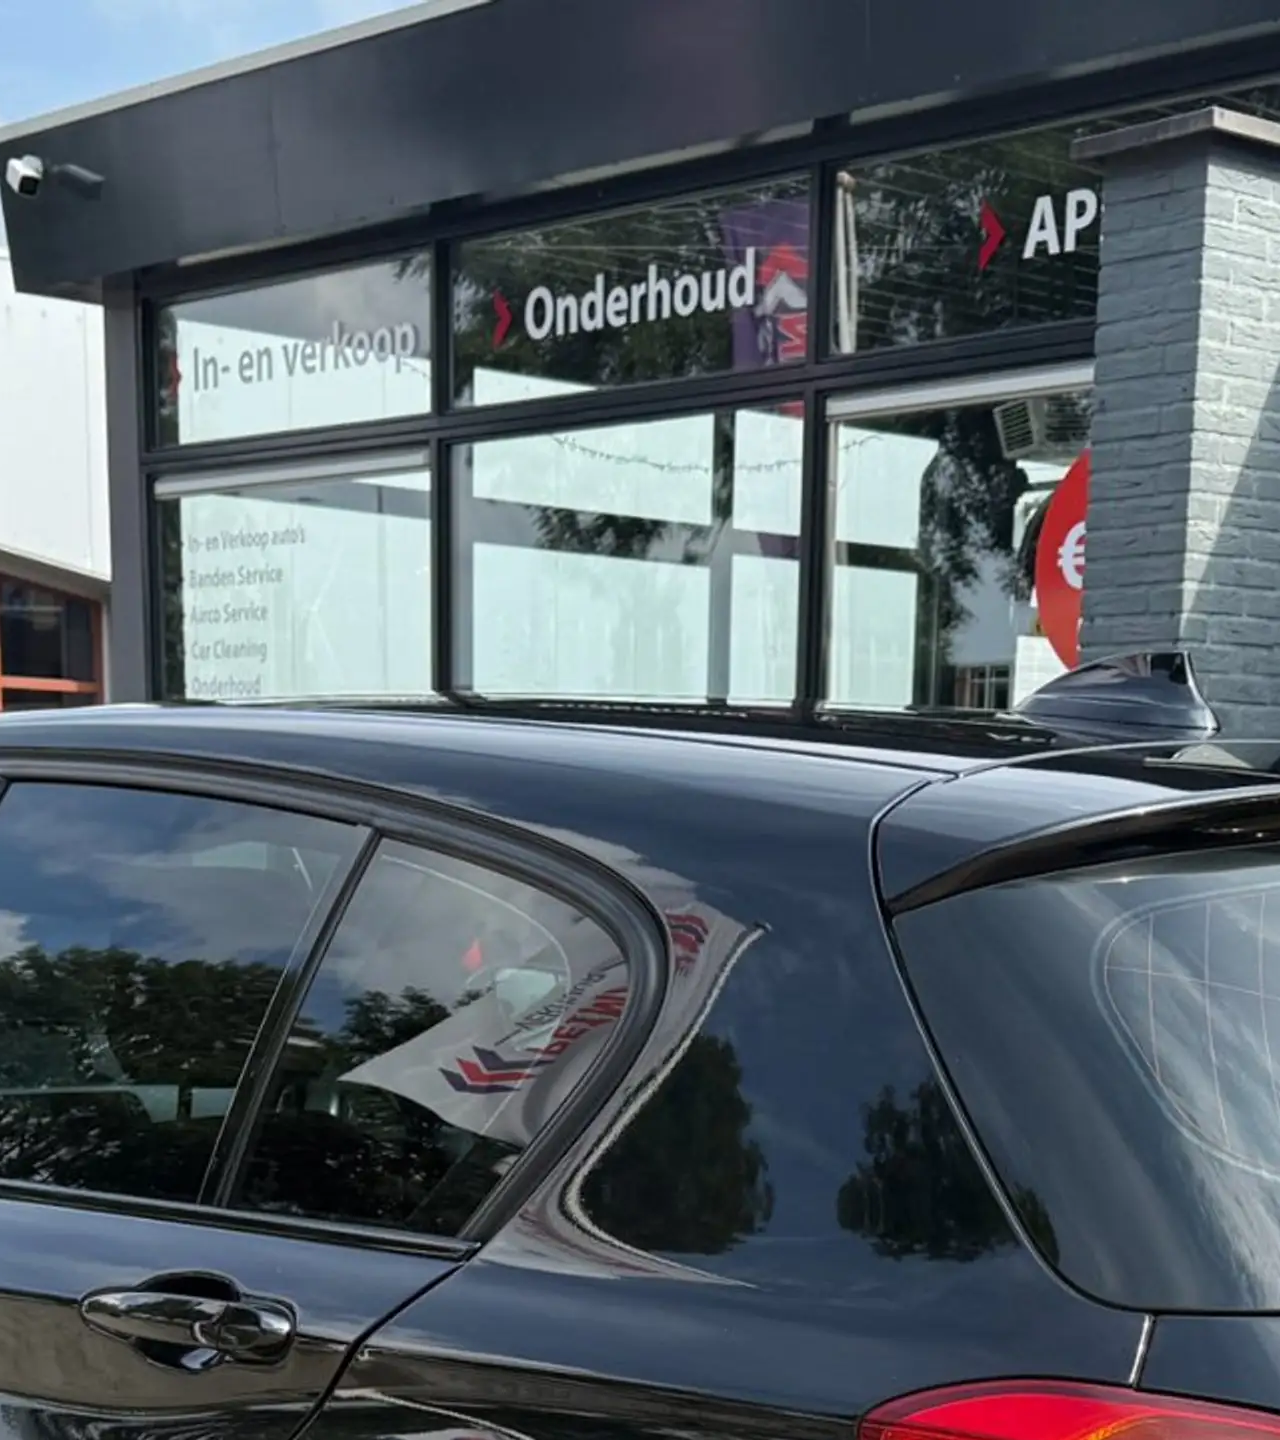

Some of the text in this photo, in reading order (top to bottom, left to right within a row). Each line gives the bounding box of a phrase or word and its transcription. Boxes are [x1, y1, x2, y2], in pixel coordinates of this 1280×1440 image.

[1022, 188, 1105, 259] AP
[524, 246, 756, 340] Onderhoud
[193, 321, 417, 391] In- en verkoop
[220, 529, 269, 550] Verkoop
[189, 563, 283, 588] Banden Service
[190, 601, 268, 625] Airco Service
[191, 636, 268, 664] Car Cleaning
[191, 676, 261, 696] Onderhoud
